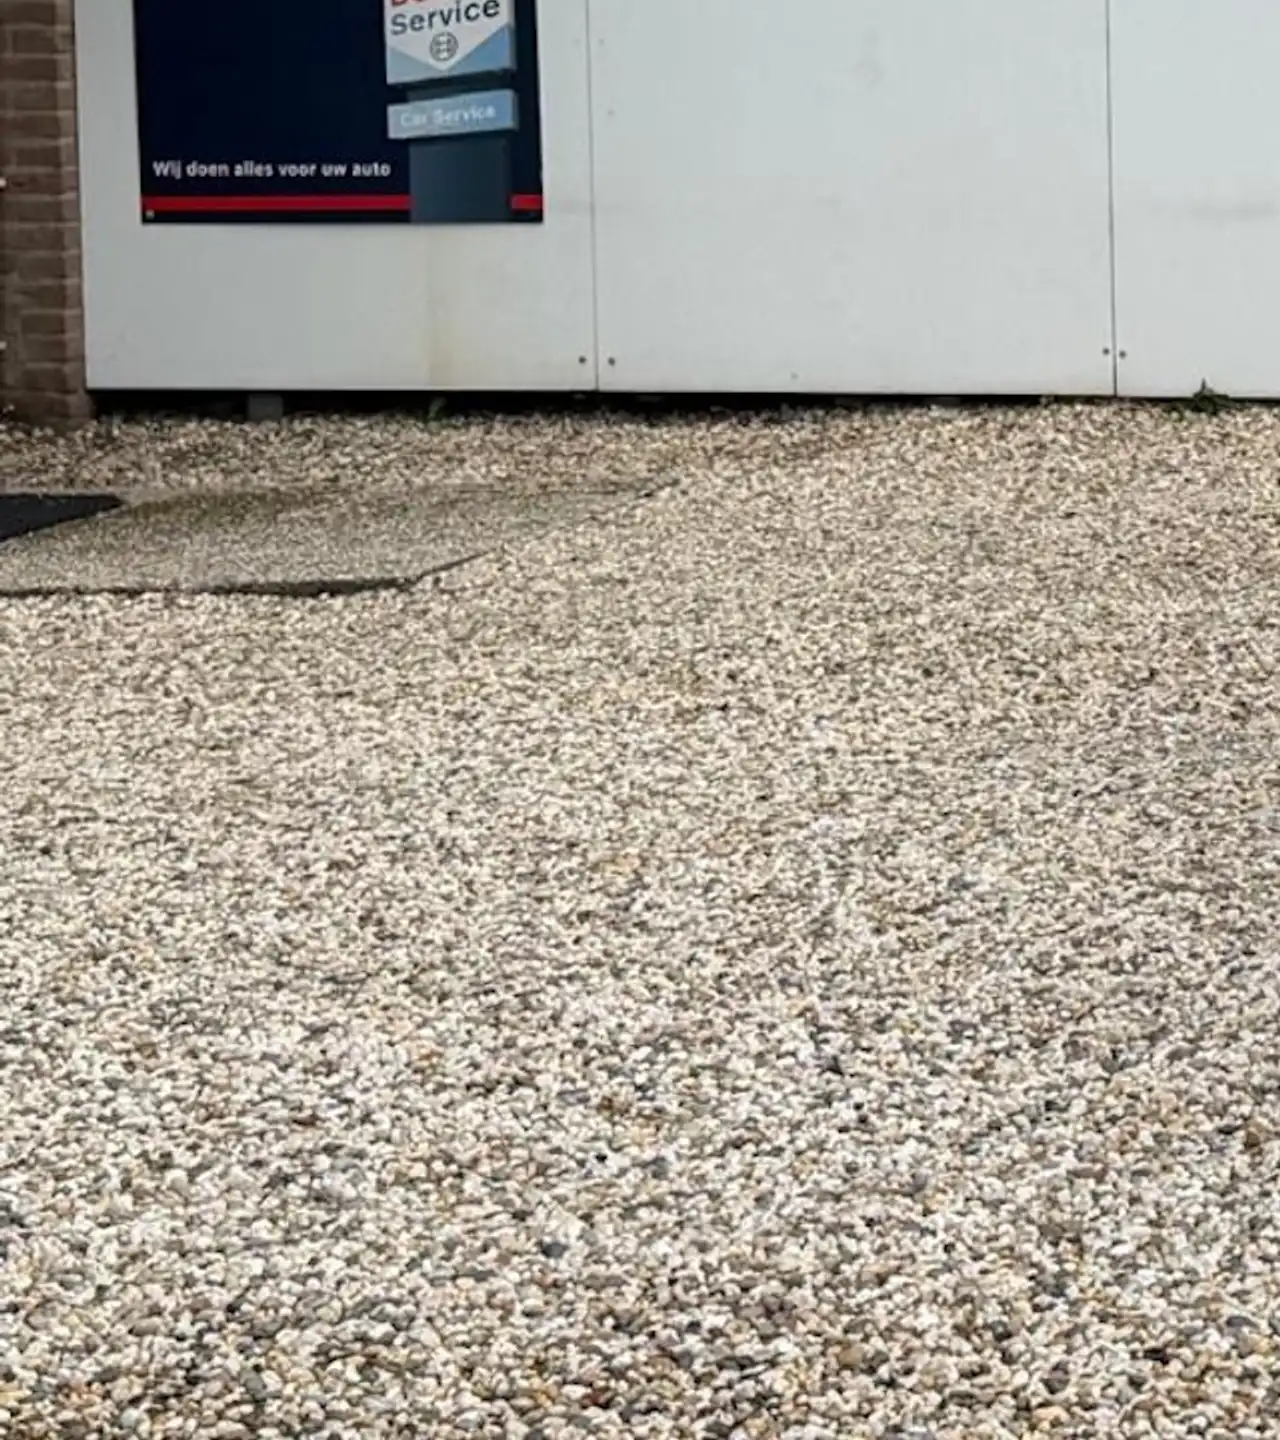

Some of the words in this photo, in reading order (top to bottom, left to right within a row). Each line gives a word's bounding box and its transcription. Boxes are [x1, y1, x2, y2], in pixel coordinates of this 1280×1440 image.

[400, 112, 428, 127] Car
[432, 105, 496, 124] Service
[153, 161, 181, 179] Wij
[185, 161, 229, 177] doen
[234, 161, 274, 177] alles
[278, 163, 317, 177] voor
[320, 163, 347, 177] uw
[352, 162, 391, 177] auto
